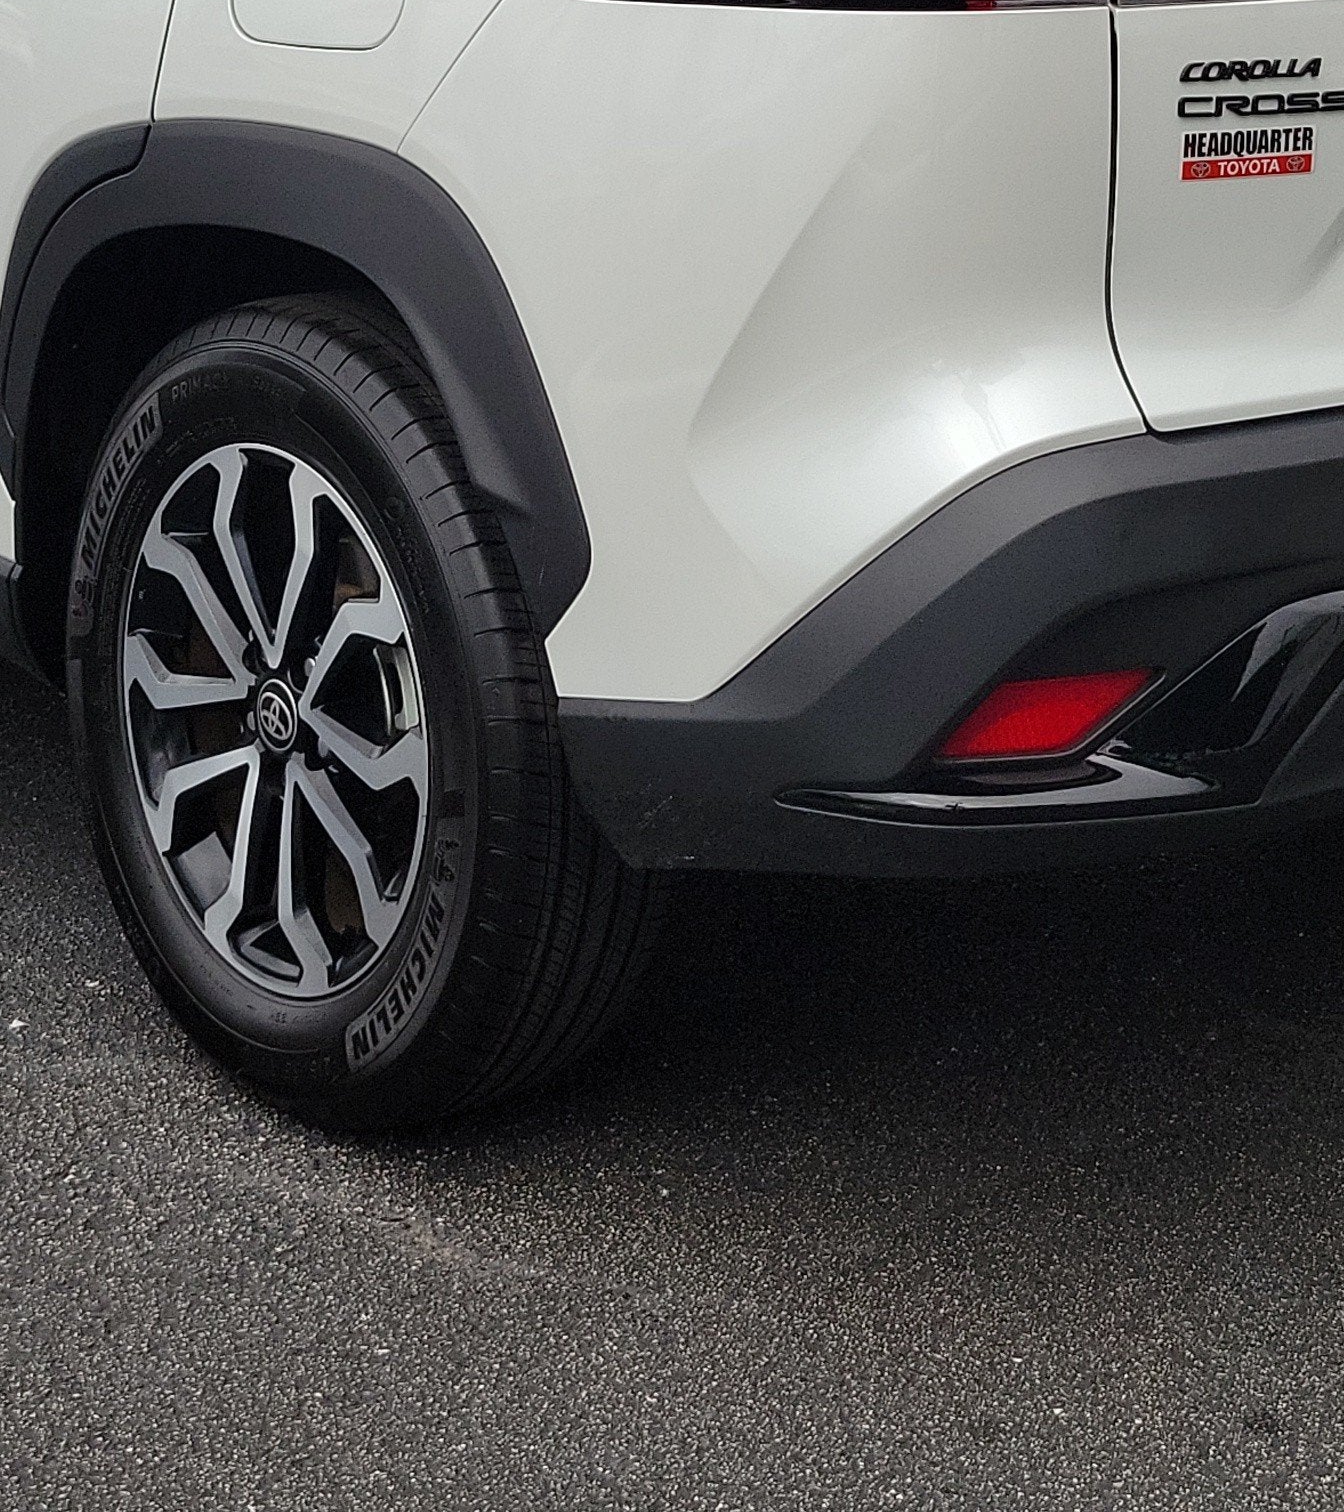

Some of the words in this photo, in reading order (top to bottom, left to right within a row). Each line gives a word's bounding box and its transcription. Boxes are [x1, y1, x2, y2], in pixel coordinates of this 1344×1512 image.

[1179, 57, 1322, 82] COROLLA
[1183, 126, 1313, 159] HEADQUARTER
[1217, 158, 1280, 176] TOYOTA
[80, 405, 157, 572] MICHELIN
[351, 892, 445, 1060] MICHELIN
